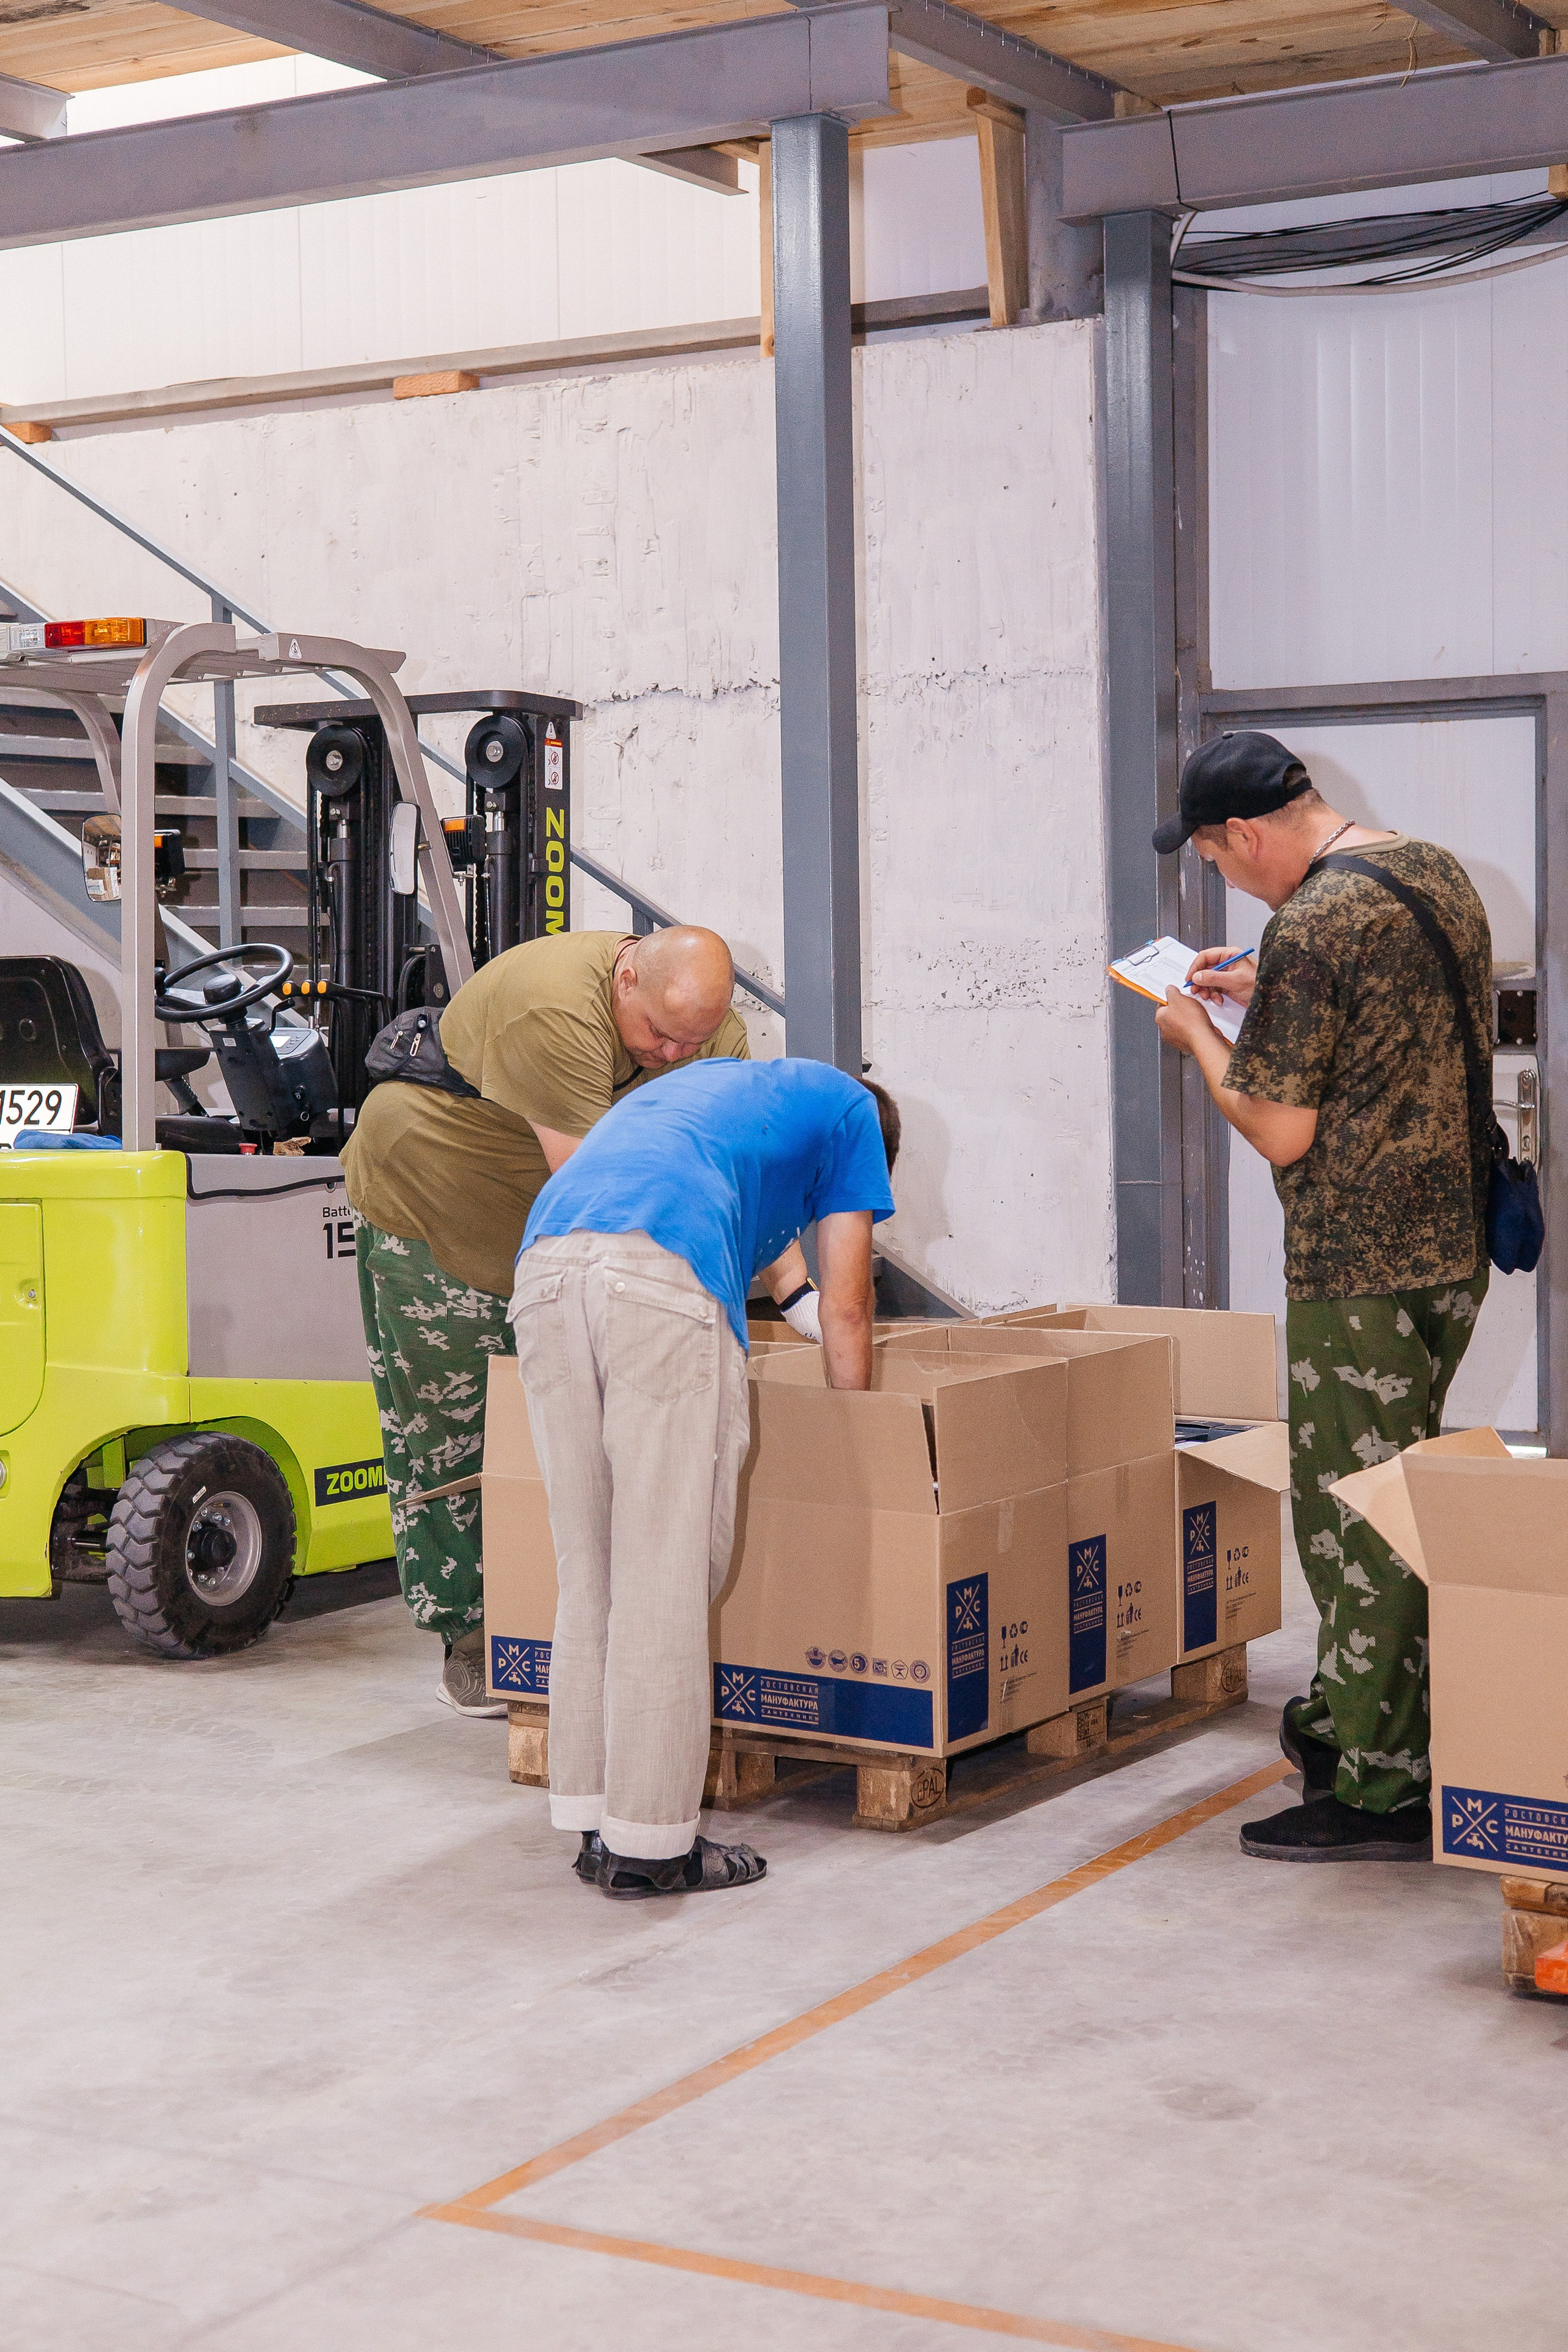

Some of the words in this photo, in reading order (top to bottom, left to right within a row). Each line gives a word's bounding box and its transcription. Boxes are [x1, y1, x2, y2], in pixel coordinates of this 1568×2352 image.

[760, 1679, 818, 1694] РОСТОВСКАЯ
[761, 1694, 818, 1711] МАНУФАКТУРА
[761, 1709, 819, 1721] САНТЕХНИКИ
